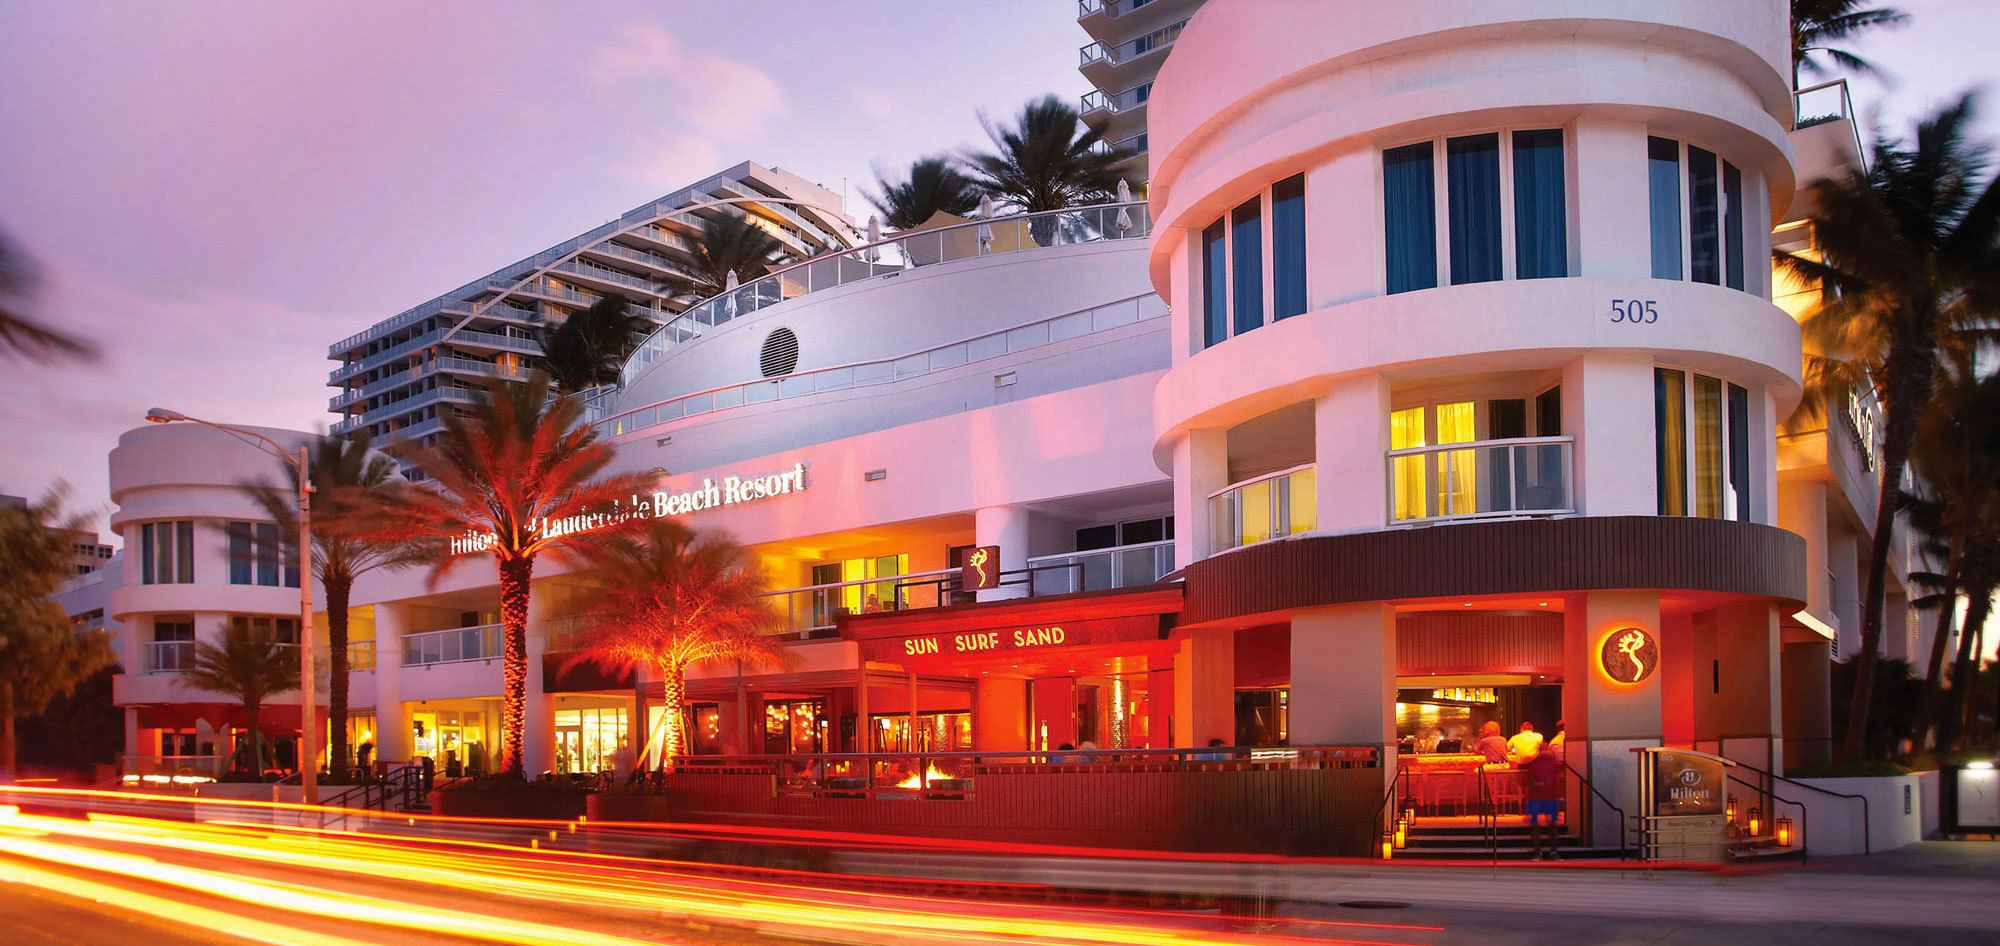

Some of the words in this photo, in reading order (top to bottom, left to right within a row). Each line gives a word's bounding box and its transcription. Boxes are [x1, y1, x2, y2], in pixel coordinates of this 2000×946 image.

[1610, 299, 1658, 324] 505
[653, 478, 721, 518] Beach
[724, 462, 805, 505] Resort
[904, 637, 939, 656] SUN
[955, 632, 1000, 652] SURF
[1013, 627, 1065, 647] SAND
[1670, 786, 1709, 799] Hilton
